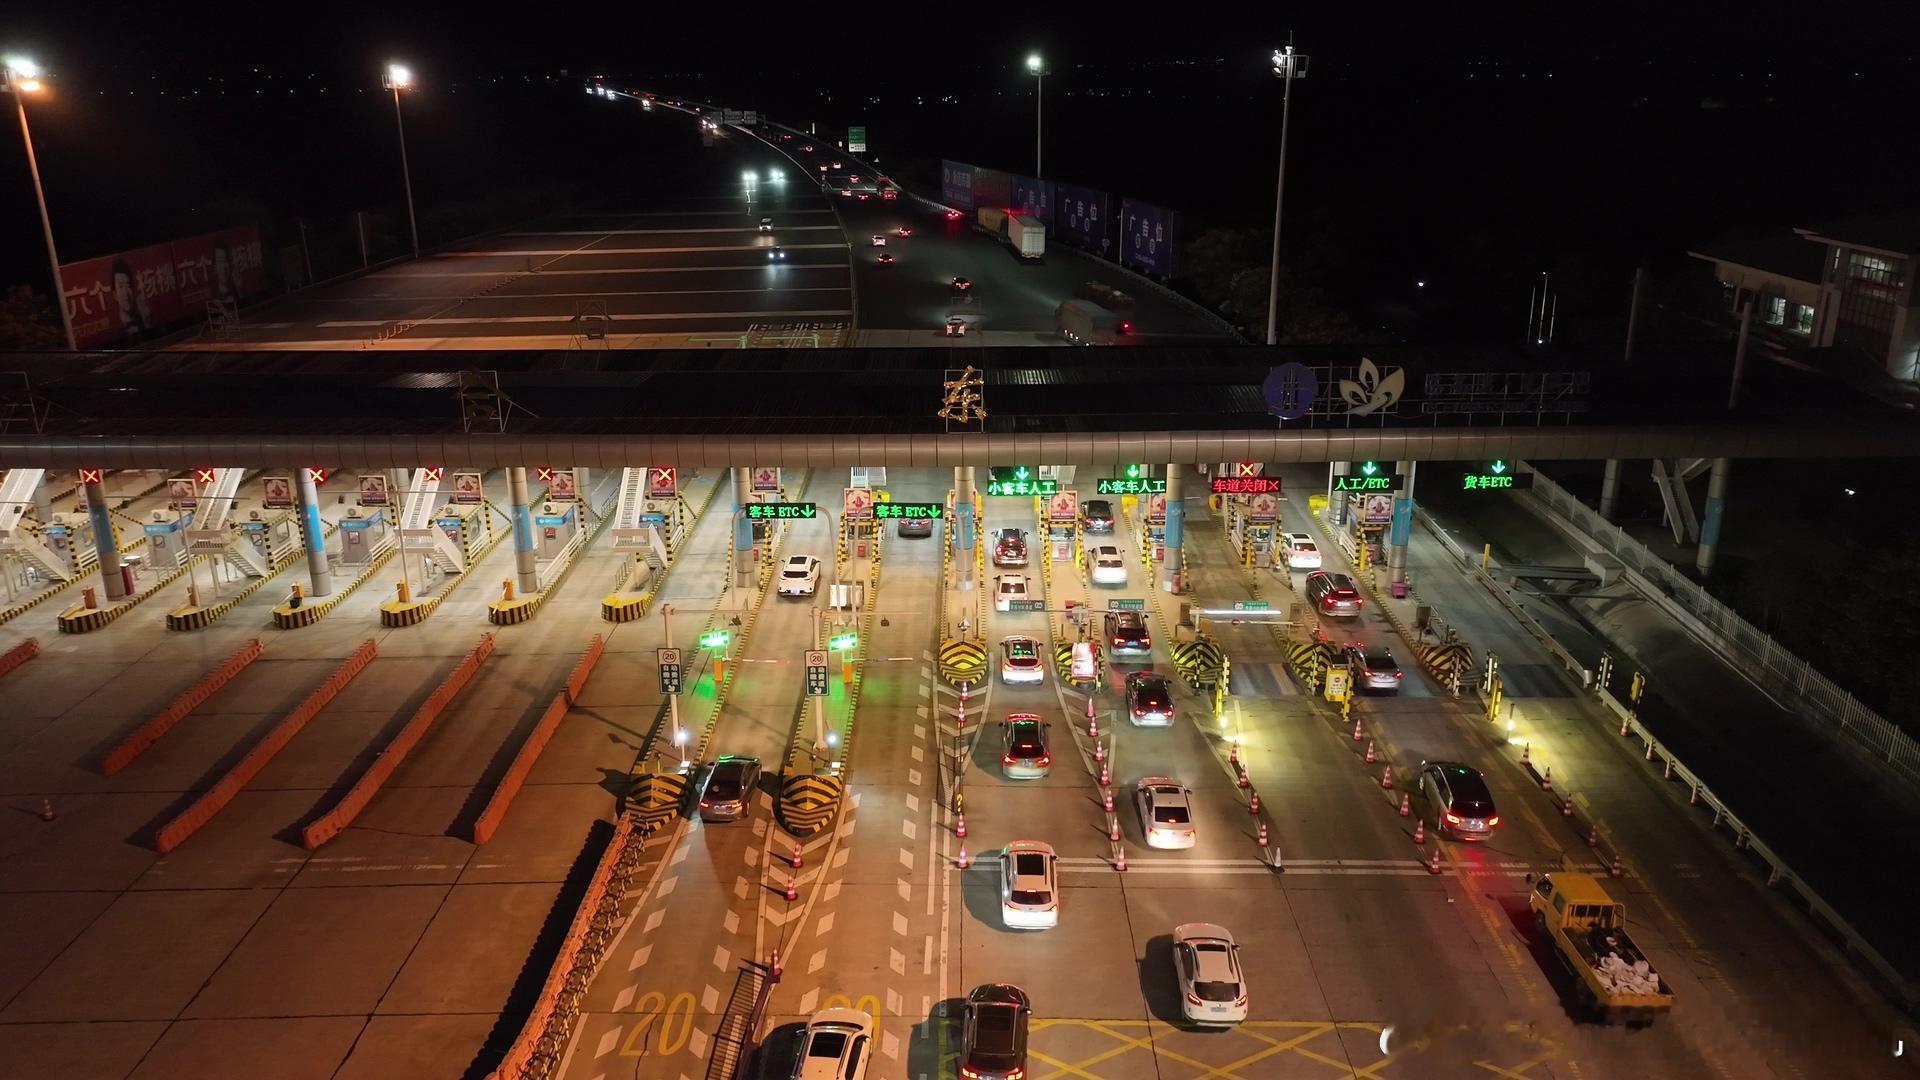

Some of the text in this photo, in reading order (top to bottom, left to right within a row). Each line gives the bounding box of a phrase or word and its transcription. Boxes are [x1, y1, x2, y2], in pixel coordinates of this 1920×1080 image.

[177, 255, 212, 289] 六个
[64, 281, 111, 319] 六个
[988, 481, 1056, 495] 小客车人工
[1098, 480, 1166, 493] 小客车人工
[1212, 479, 1267, 493] 车道关闭
[1334, 477, 1390, 491] 人工/ETC
[1463, 475, 1513, 490] 货车ETC
[748, 505, 800, 518] 客车 ETC
[876, 505, 927, 518] 客车 ETC
[619, 991, 696, 1056] 20
